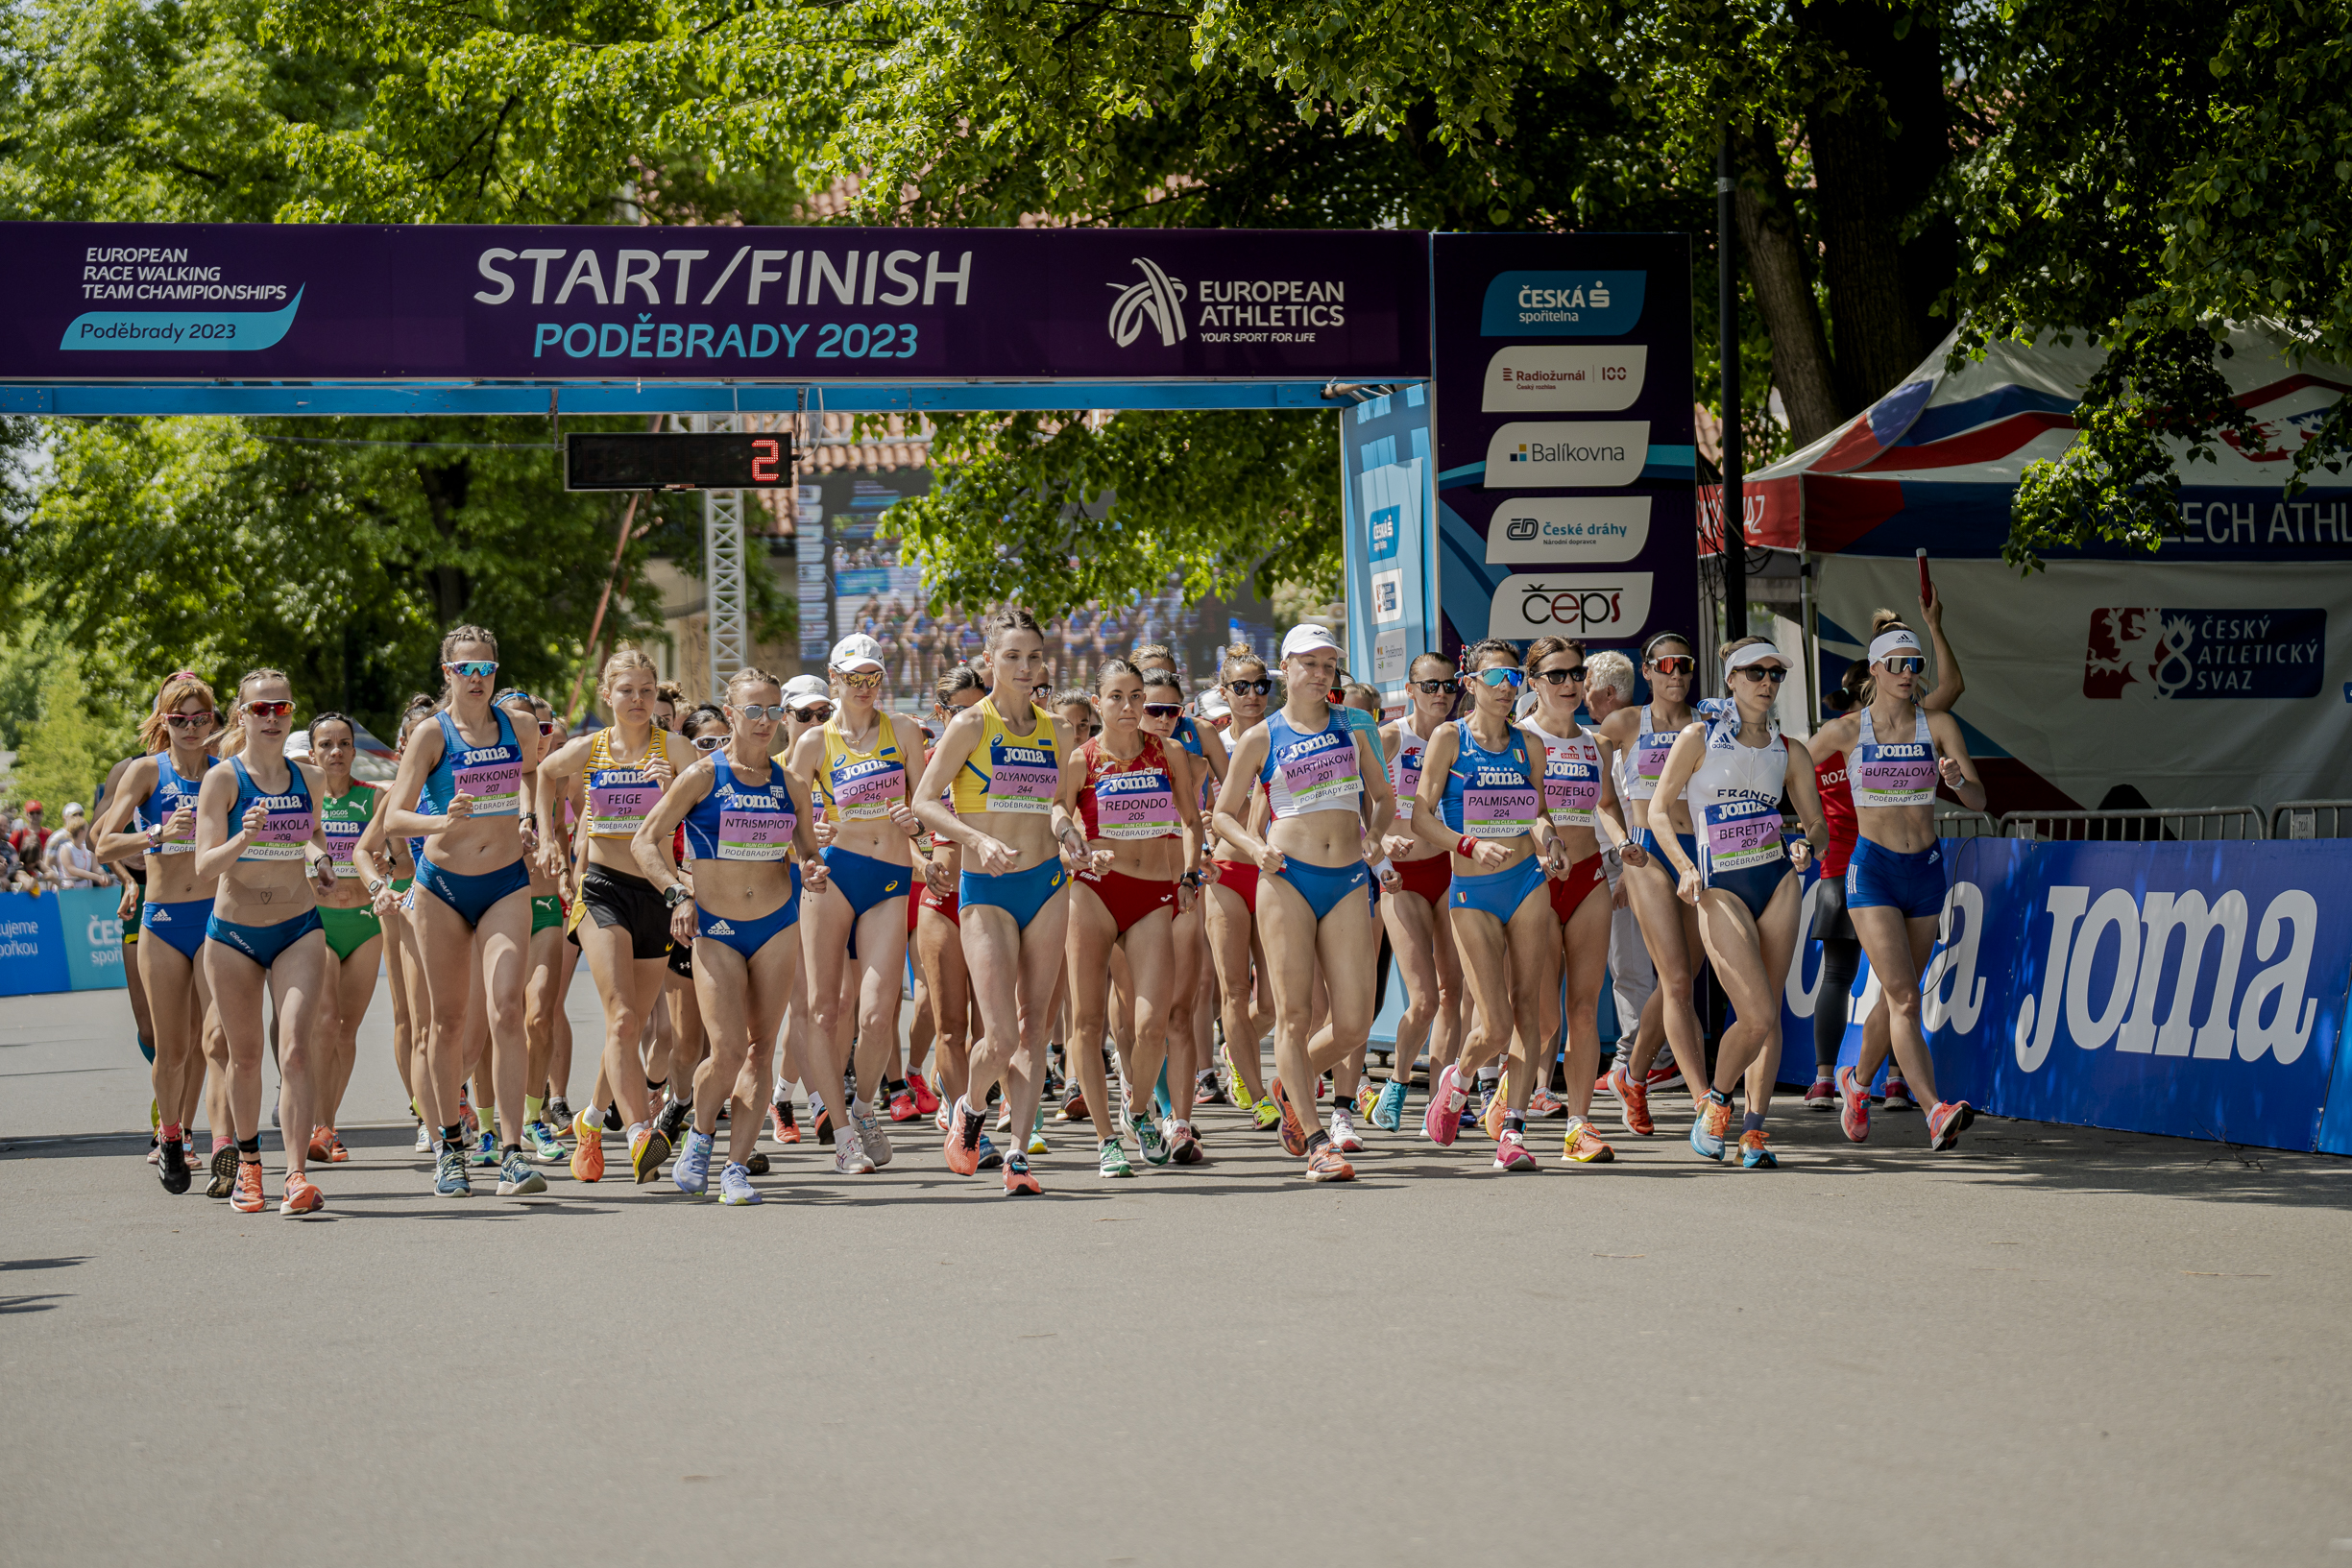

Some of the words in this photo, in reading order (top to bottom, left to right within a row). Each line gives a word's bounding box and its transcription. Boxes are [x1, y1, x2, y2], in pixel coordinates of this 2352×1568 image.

[85, 247, 188, 263] EUROPEAN
[83, 265, 134, 281] RACE
[137, 266, 222, 281] WALKING
[473, 245, 973, 306] START/FINISH
[82, 283, 135, 300] TEAM
[136, 284, 287, 301] CHAMPIONSHIPS
[1200, 280, 1345, 302] EUROPEAN
[1517, 284, 1587, 308] ČESKÁ
[1199, 304, 1346, 326] ATHLETICS
[1518, 310, 1580, 325] spořitelna
[80, 322, 185, 345] Poděbrady
[188, 324, 237, 339] 2023
[533, 312, 810, 359] PODĚBRADY
[816, 323, 918, 359] 2023
[1200, 332, 1231, 343] YOUR
[1232, 332, 1269, 343] SPORT
[1271, 332, 1293, 343] FOR
[1295, 332, 1317, 343] LIFE
[1515, 369, 1586, 382] Radiožurnál
[1602, 366, 1627, 381] 100
[1531, 443, 1625, 462] Balíkovna
[751, 439, 780, 482] 2
[1542, 521, 1583, 536] České
[1587, 522, 1628, 538] dráhy
[2201, 614, 2271, 640] ČESKÝ
[2196, 638, 2318, 664] ATLETICKÝ
[2196, 670, 2253, 690] SVAZ
[1711, 742, 1735, 751] adidas
[1286, 750, 1355, 780] MARTÍNKOVÁ
[1865, 763, 1935, 777] BURZALOVÁ
[459, 767, 521, 784] NIRKKONEN
[995, 771, 1057, 784] OLYANOVSKA
[1317, 769, 1334, 782] 201
[1820, 769, 1848, 786] ROZ
[485, 783, 500, 793] 207
[842, 775, 900, 800] SOBCHUK
[1016, 784, 1033, 794] 244
[1344, 783, 1359, 791] 2023
[1892, 779, 1909, 788] 237
[175, 794, 198, 808] Jo
[608, 793, 643, 805] FEIGE
[863, 791, 882, 801] 246
[1468, 795, 1535, 807] PALMISANO
[1561, 798, 1576, 807] 231
[1716, 788, 1778, 806] FRANCE
[1912, 792, 1928, 802] 2023
[1104, 797, 1168, 811] REDONDO
[329, 808, 349, 817] JOGOS
[1128, 811, 1146, 821] 205
[1493, 808, 1511, 818] 224
[321, 821, 360, 833] oma
[725, 817, 793, 830] NTRISMPIOTI
[1719, 821, 1775, 840] BERETTA
[273, 832, 292, 841] 208
[751, 832, 767, 841] 215
[1740, 837, 1758, 848] 209
[1765, 849, 1779, 860] 2023
[436, 875, 453, 897] CRAFT
[0, 919, 39, 938] ujeme
[229, 930, 252, 952] CRAFT
